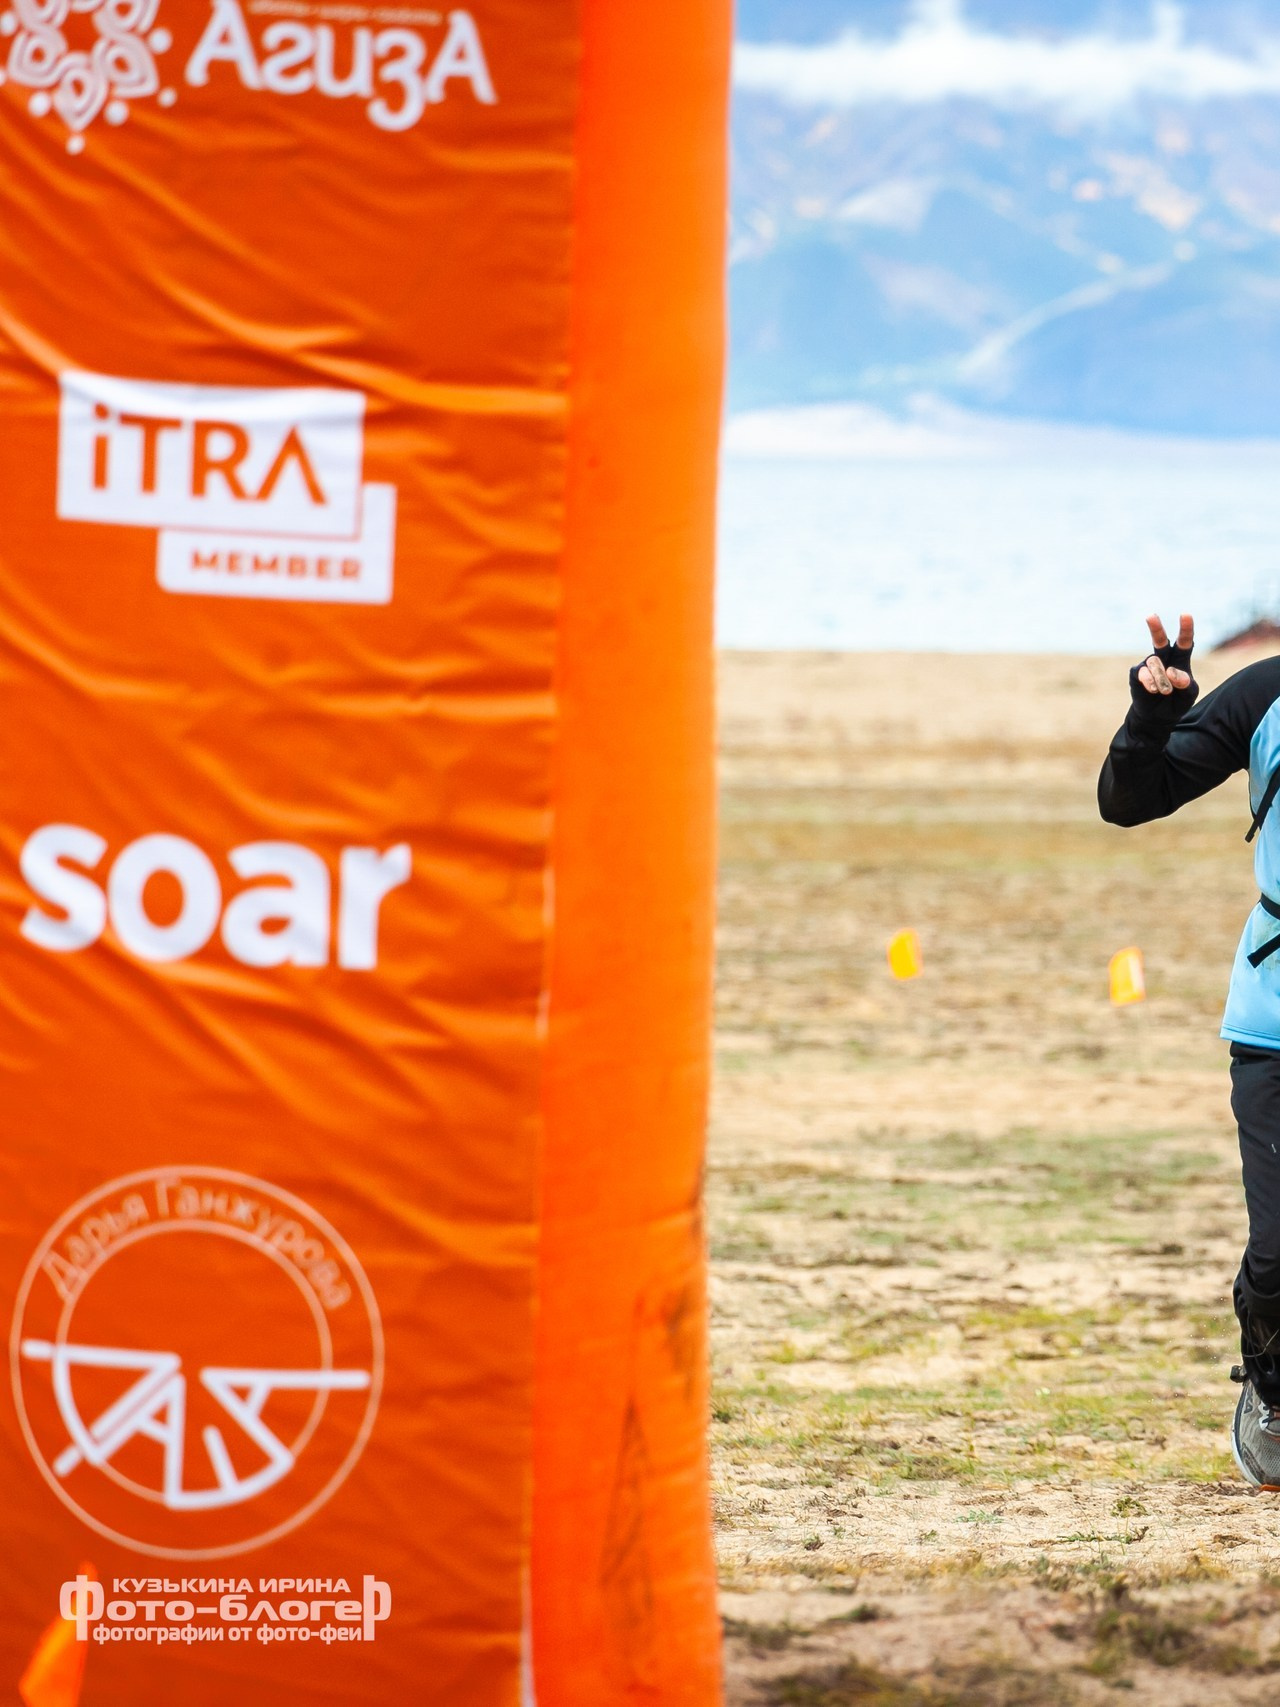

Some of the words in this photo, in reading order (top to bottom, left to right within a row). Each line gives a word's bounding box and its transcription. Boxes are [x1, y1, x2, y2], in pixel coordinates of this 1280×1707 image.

[191, 549, 362, 581] MEMBER
[19, 822, 413, 971] soar
[40, 1193, 149, 1302] Дарья
